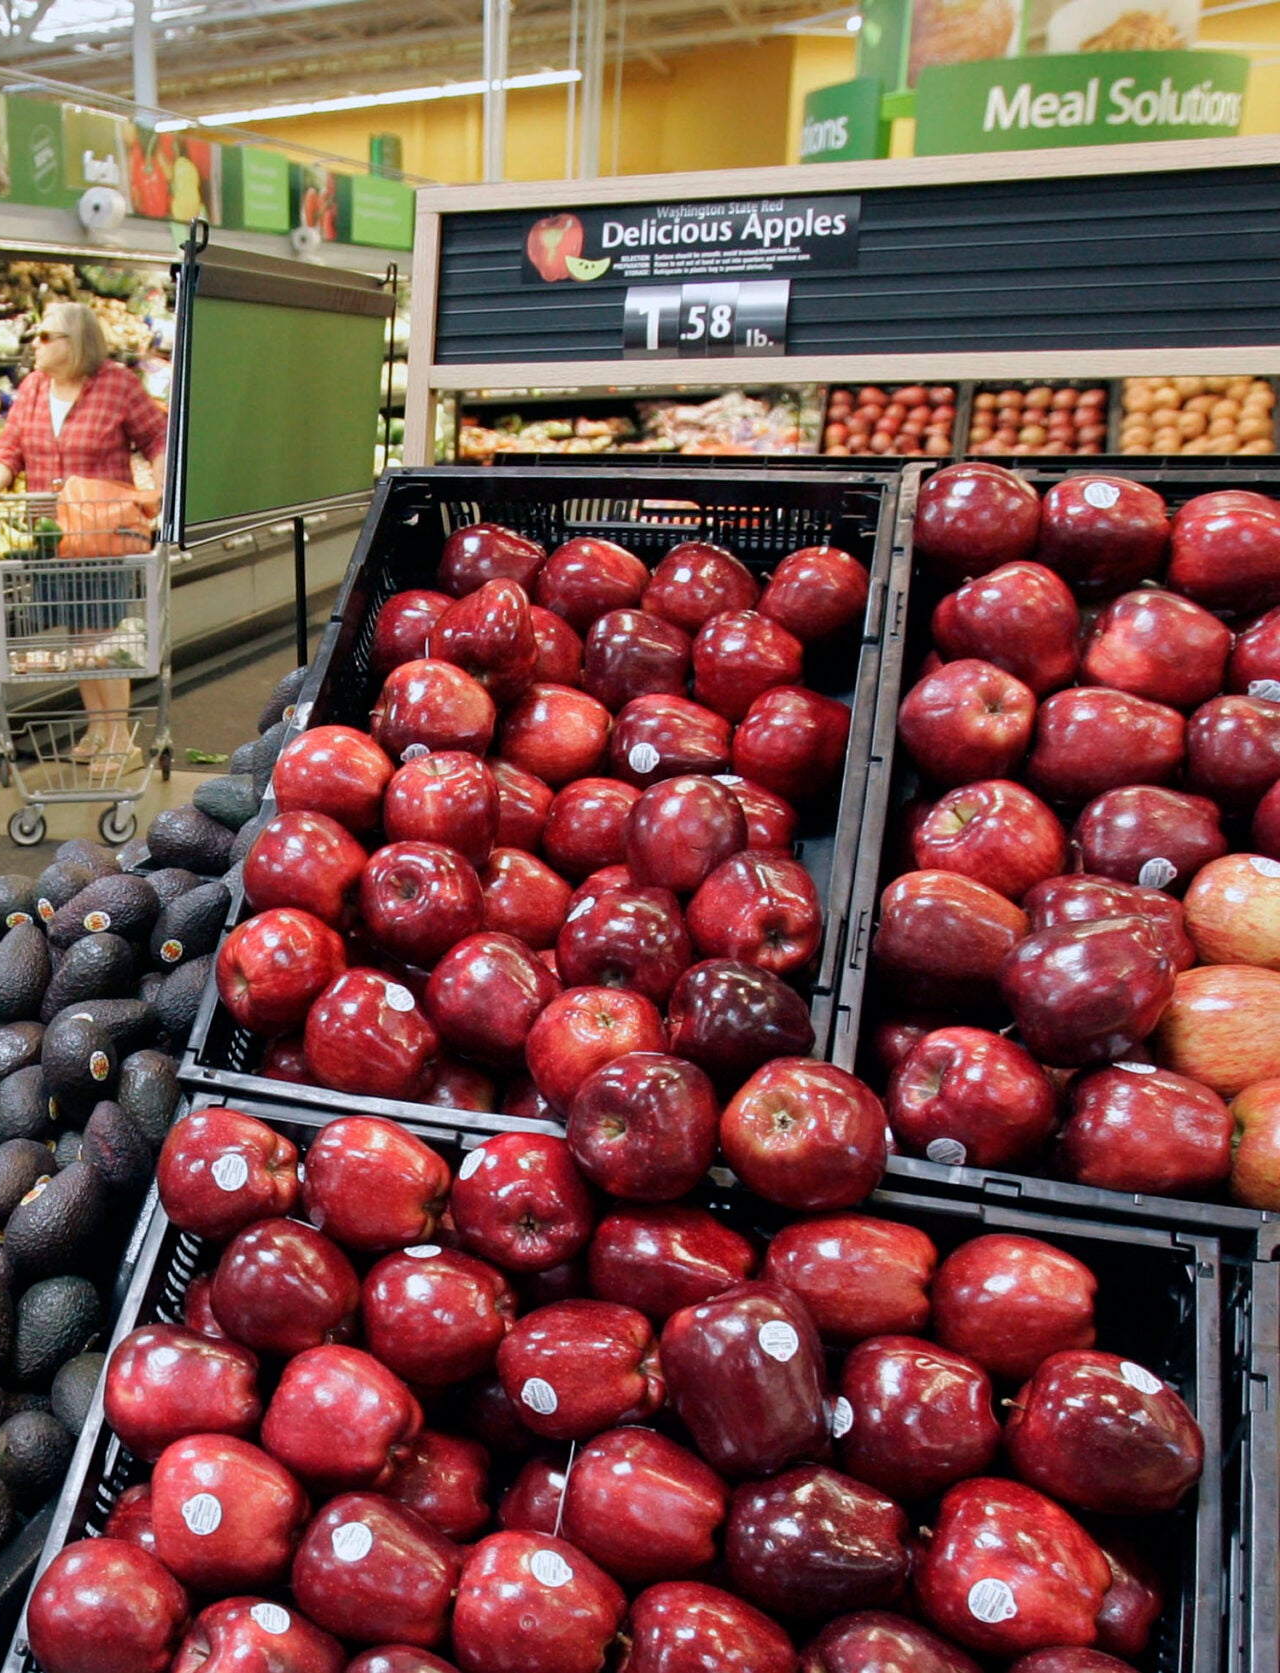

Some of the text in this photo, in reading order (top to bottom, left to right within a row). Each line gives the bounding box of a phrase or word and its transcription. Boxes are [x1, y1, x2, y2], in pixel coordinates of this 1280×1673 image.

[983, 76, 1243, 132] Meal Solutions
[657, 199, 784, 220] Washington State Red
[601, 207, 847, 249] Delicious Apples
[745, 328, 774, 348] lb.
